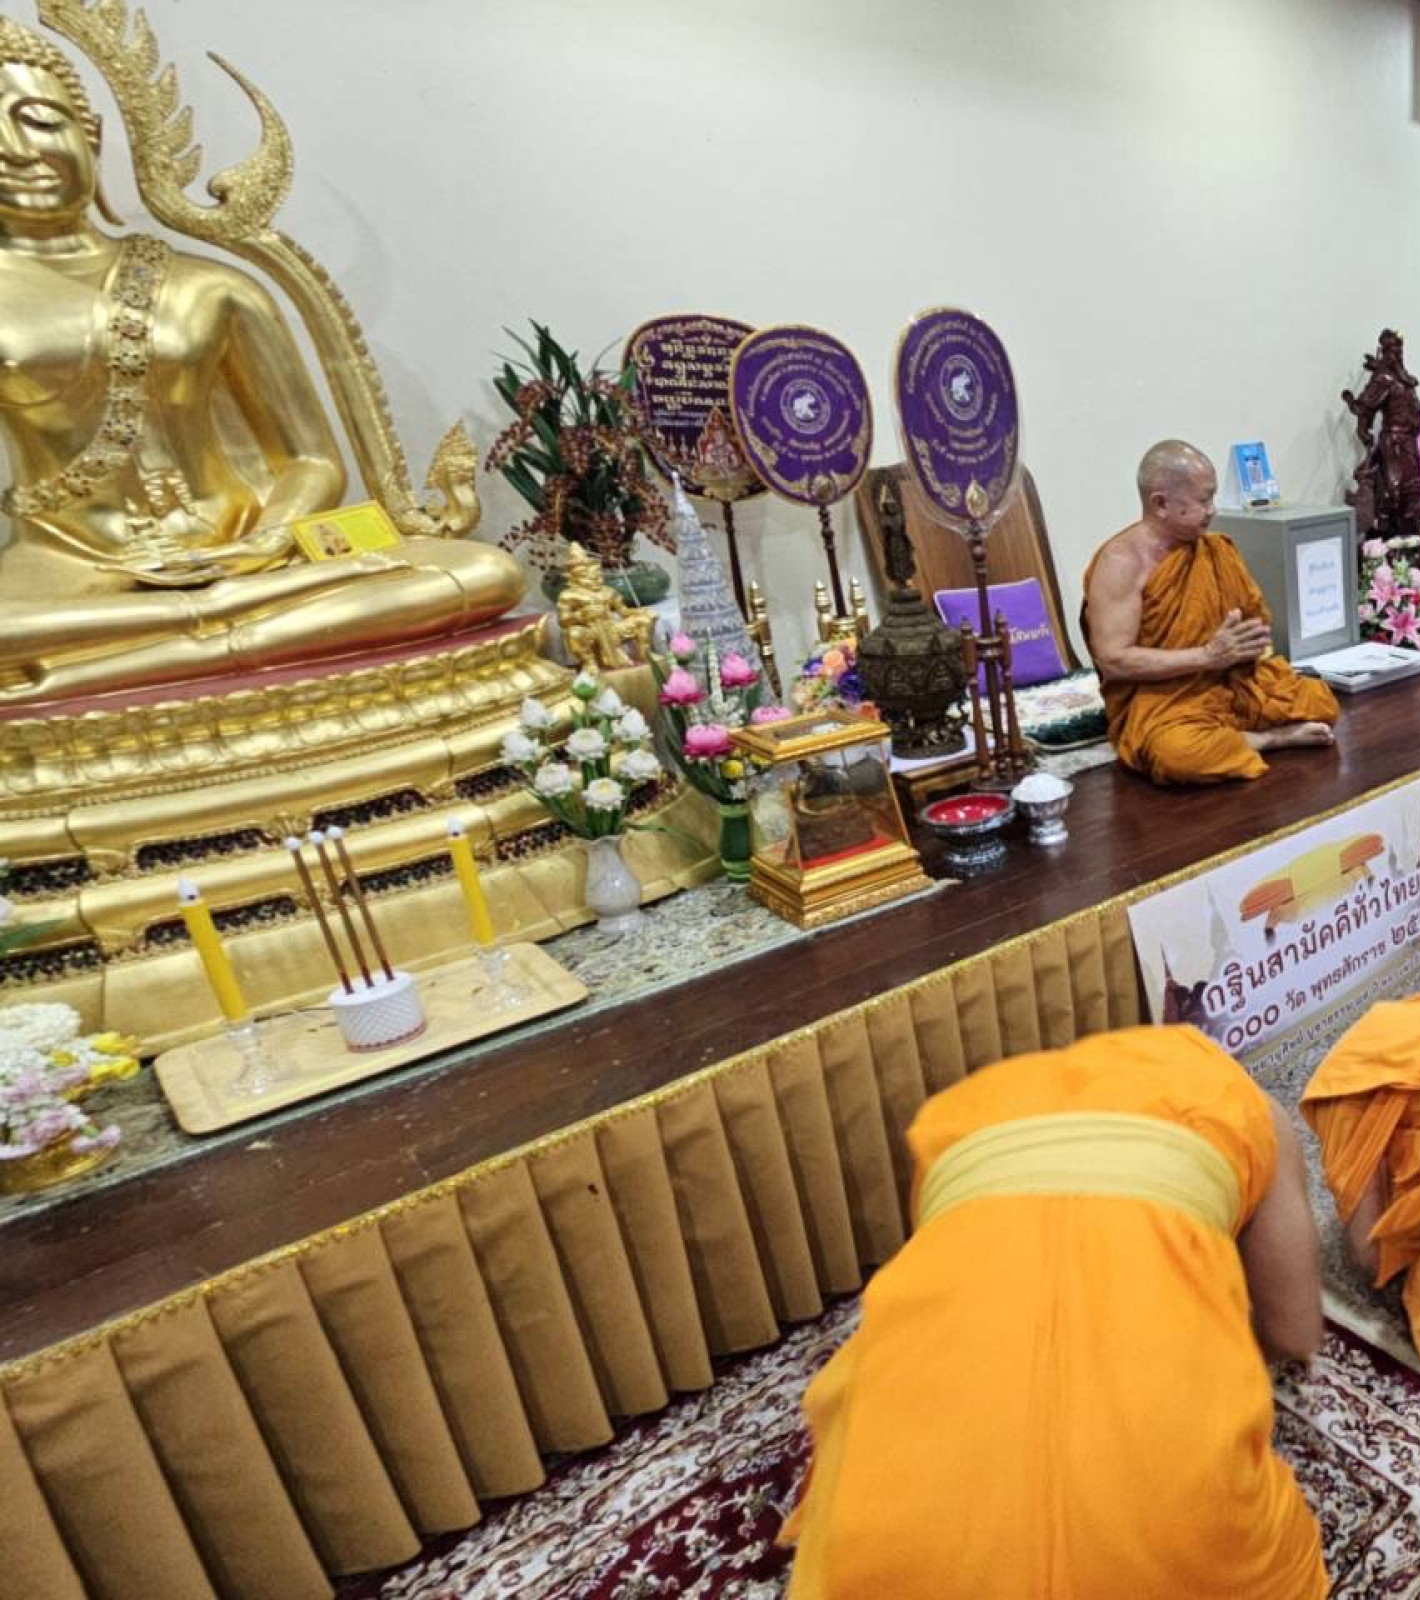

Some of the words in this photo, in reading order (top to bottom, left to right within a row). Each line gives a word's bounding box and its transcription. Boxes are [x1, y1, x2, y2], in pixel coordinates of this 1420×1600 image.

[1286, 987, 1306, 1012] วัด
[1310, 940, 1386, 1001] พุทธศักราช
